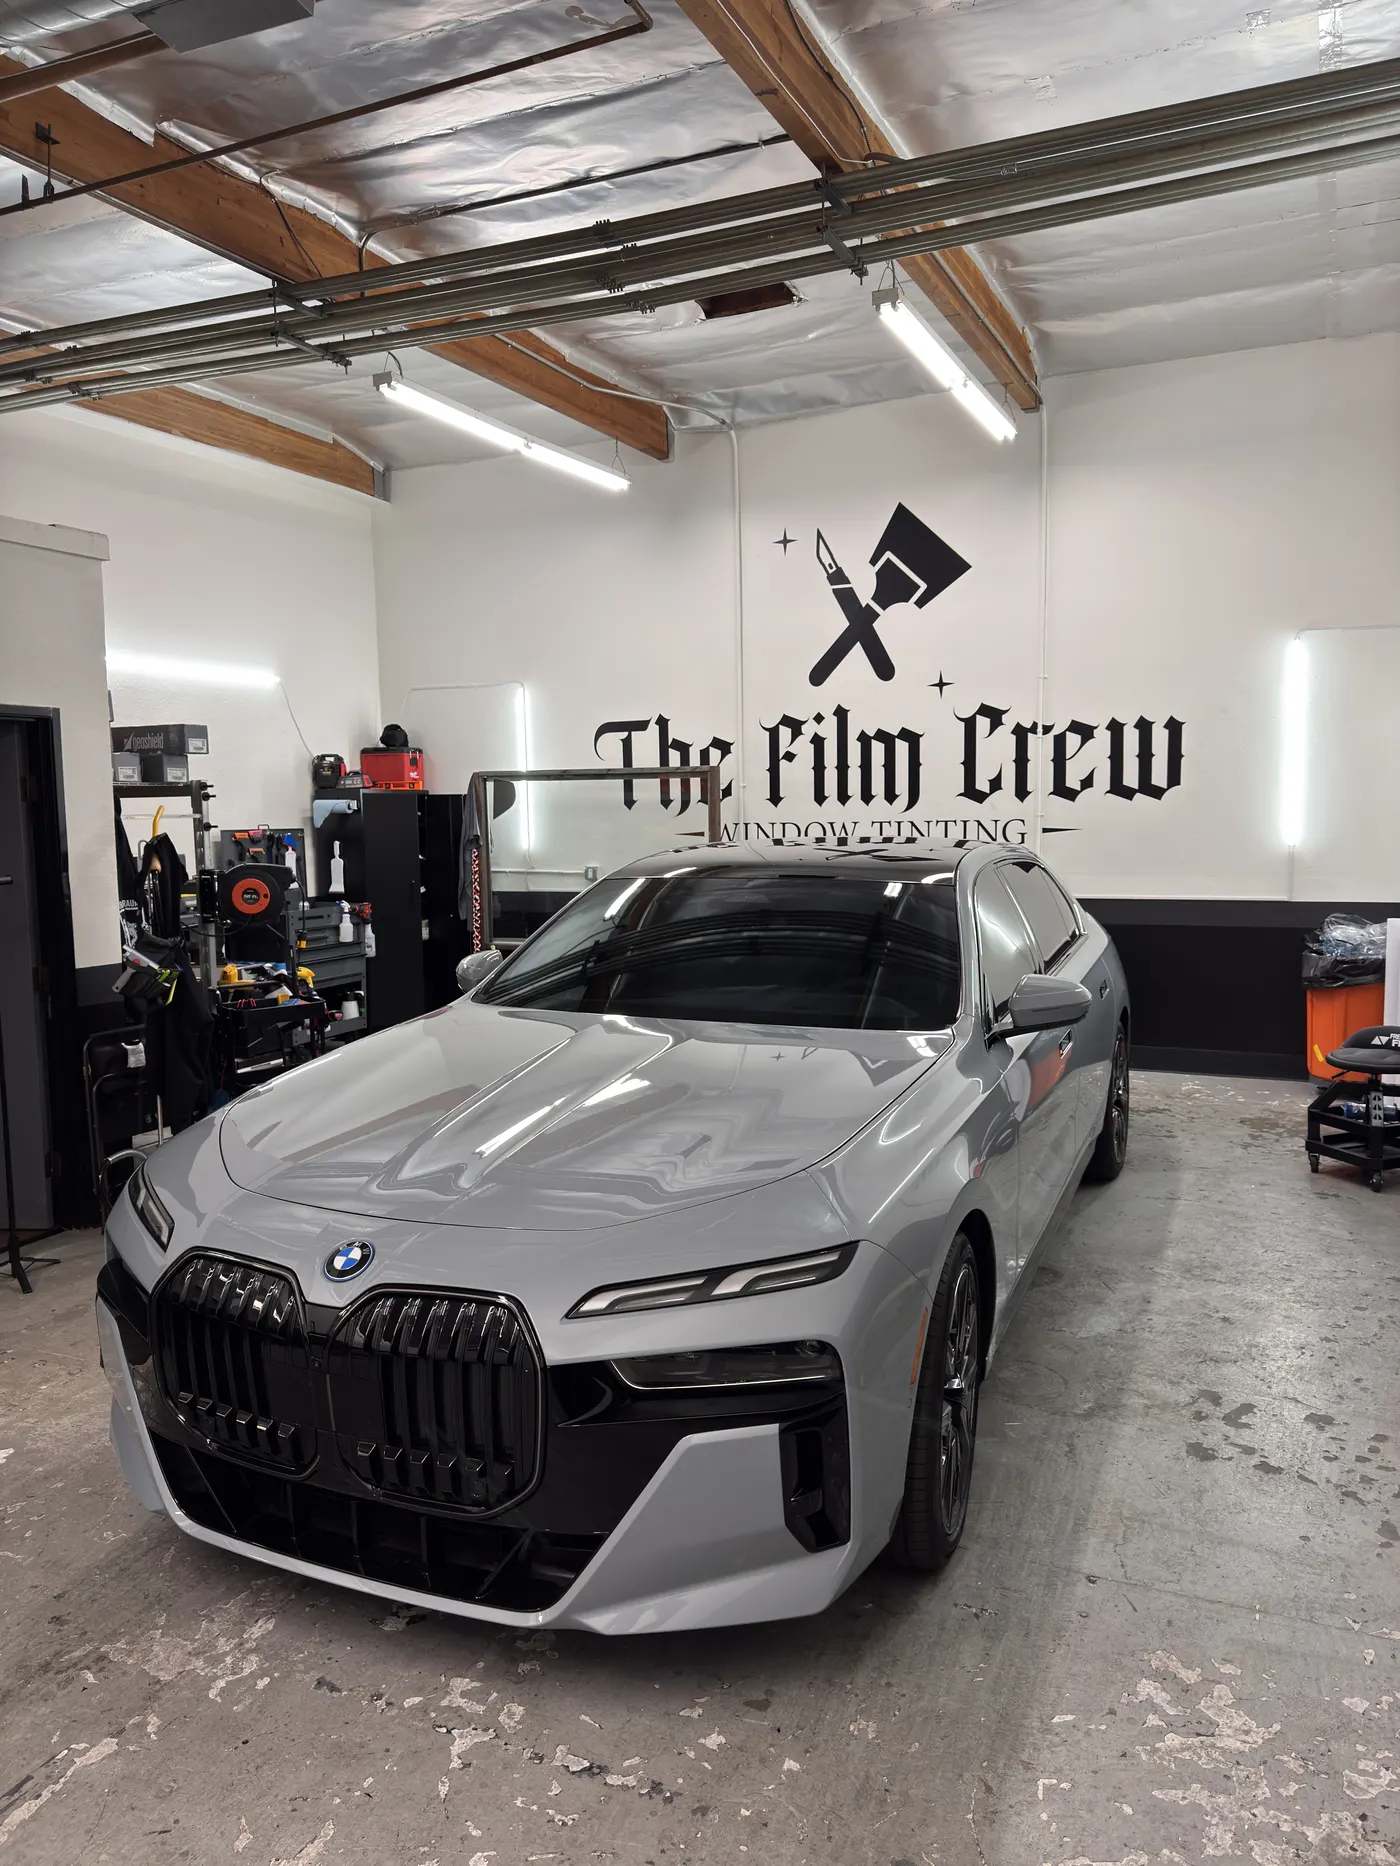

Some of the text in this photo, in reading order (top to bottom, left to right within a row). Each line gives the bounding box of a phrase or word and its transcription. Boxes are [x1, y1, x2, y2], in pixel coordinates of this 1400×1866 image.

[132, 732, 164, 751] geoshield
[593, 702, 1187, 817] The Film Crew
[871, 818, 1028, 845] TINTING
